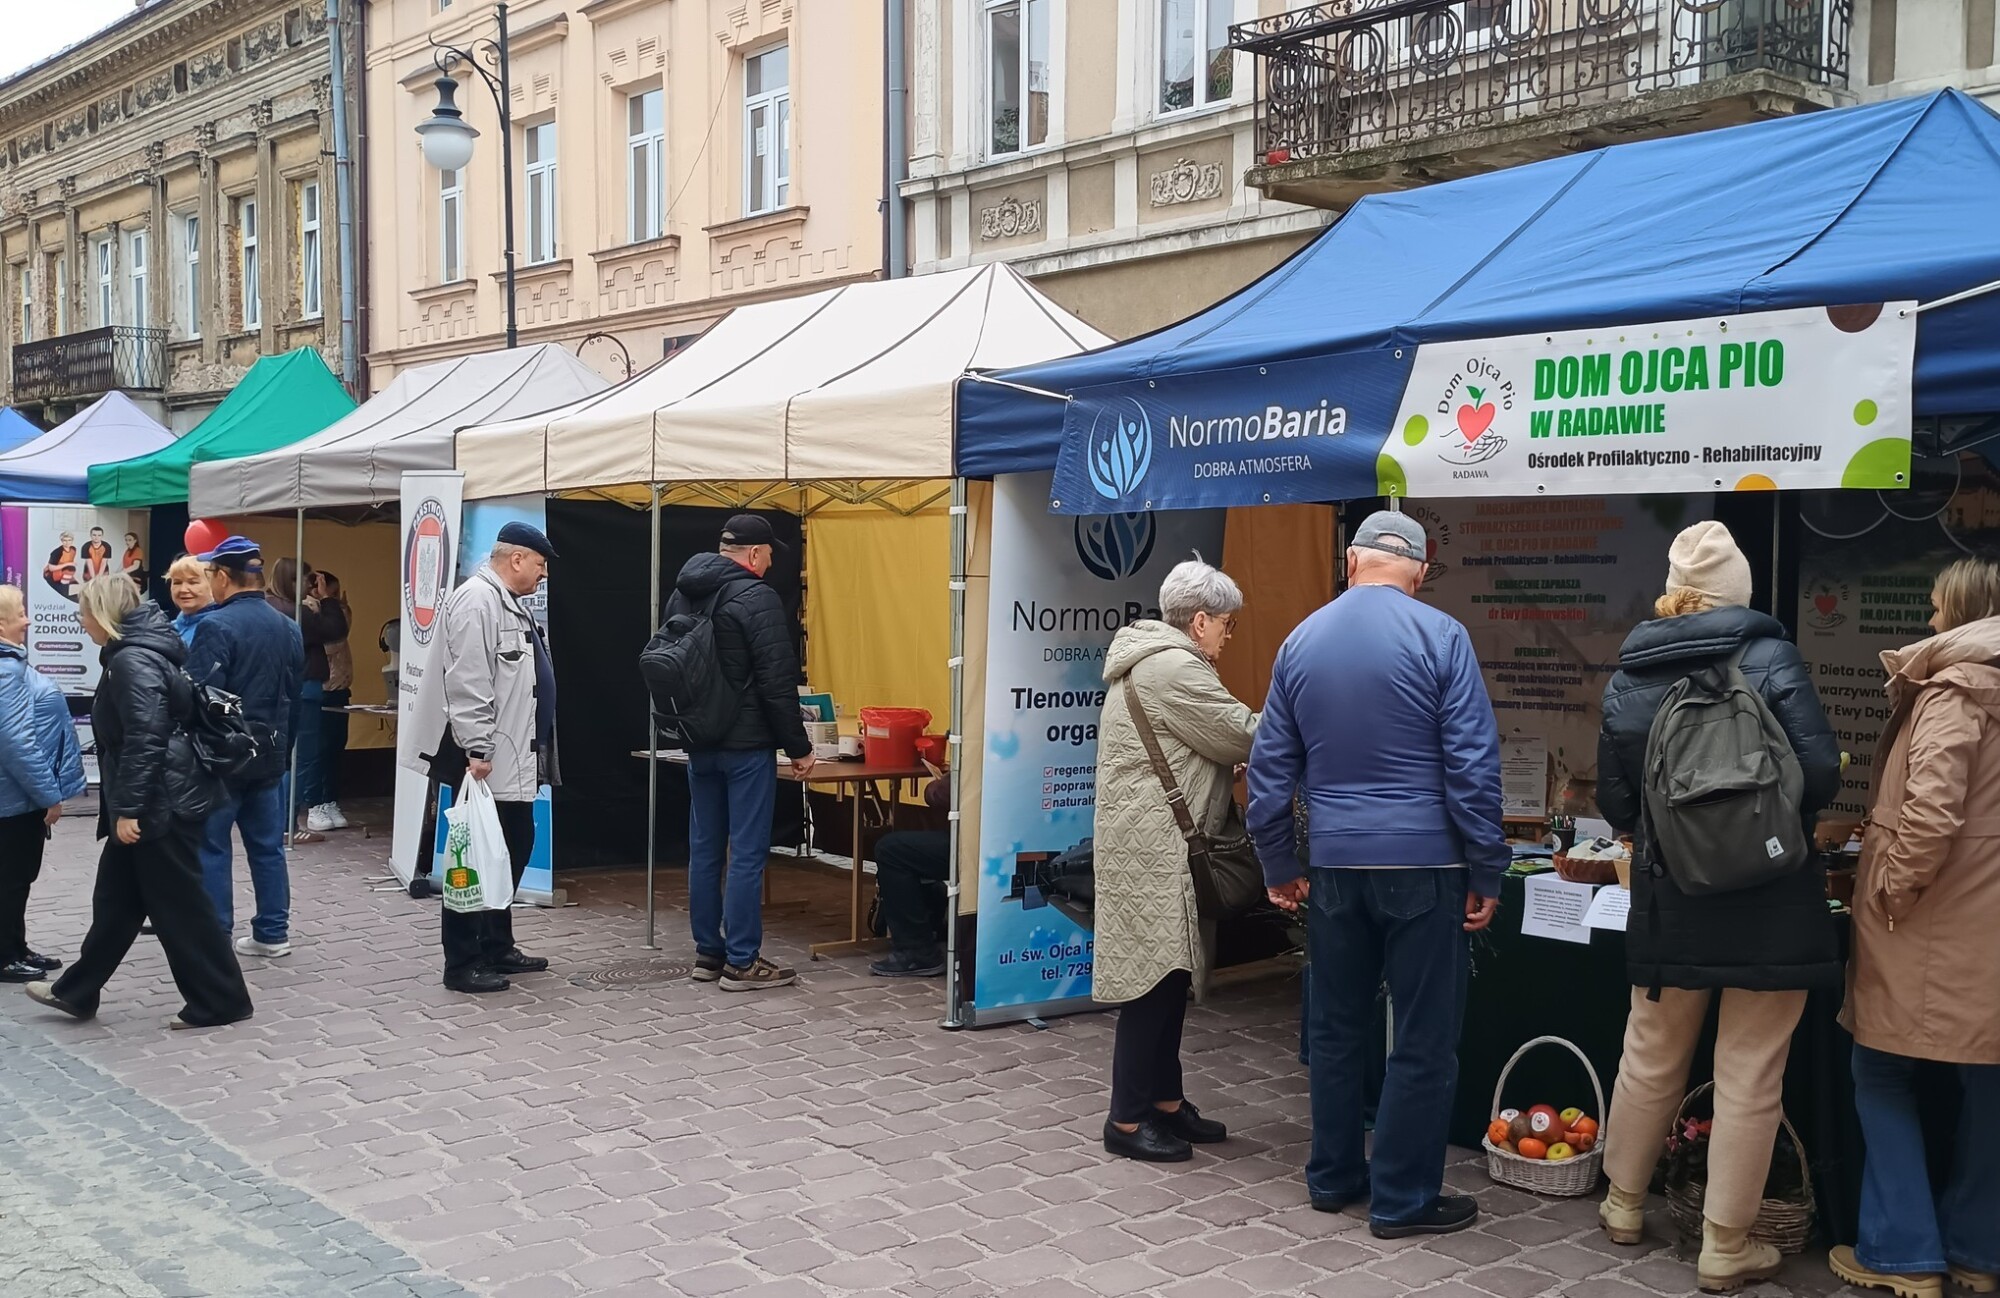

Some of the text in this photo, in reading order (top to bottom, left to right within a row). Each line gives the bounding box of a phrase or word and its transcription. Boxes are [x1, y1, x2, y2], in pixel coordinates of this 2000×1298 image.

[1534, 339, 1784, 401] DOM OJCA PIO
[1437, 356, 1516, 415] Dom Ojca Pio
[1168, 400, 1347, 449] NormoBaria
[1530, 403, 1666, 439] W RADAWIE
[1528, 451, 1585, 469] Ośrodek
[1587, 448, 1690, 467] Profilaktyczno
[1702, 443, 1822, 464] Rehabilitacyjny
[1193, 454, 1312, 479] DOBRA ATMOSFERA
[1452, 470, 1489, 479] RADAWA
[1416, 506, 1452, 545] Ojca Pio
[1496, 537, 1520, 551] OJCA
[1521, 537, 1538, 551] PIO
[34, 603, 66, 611] Wydział
[1043, 648, 1091, 662] DOBRA
[1820, 663, 1889, 681] Dieta oczy
[1011, 688, 1106, 709] Tlenowa
[1834, 704, 1862, 720] Ewy
[1865, 706, 1892, 721] Dąb
[1046, 723, 1098, 746] orga
[1850, 754, 1873, 766] bili
[1054, 765, 1097, 778] regener
[1053, 781, 1095, 795] popraw
[999, 950, 1017, 964] ul.
[1021, 946, 1045, 962] św.
[1049, 943, 1081, 961] Ojca
[1041, 963, 1092, 981] tel. 729
